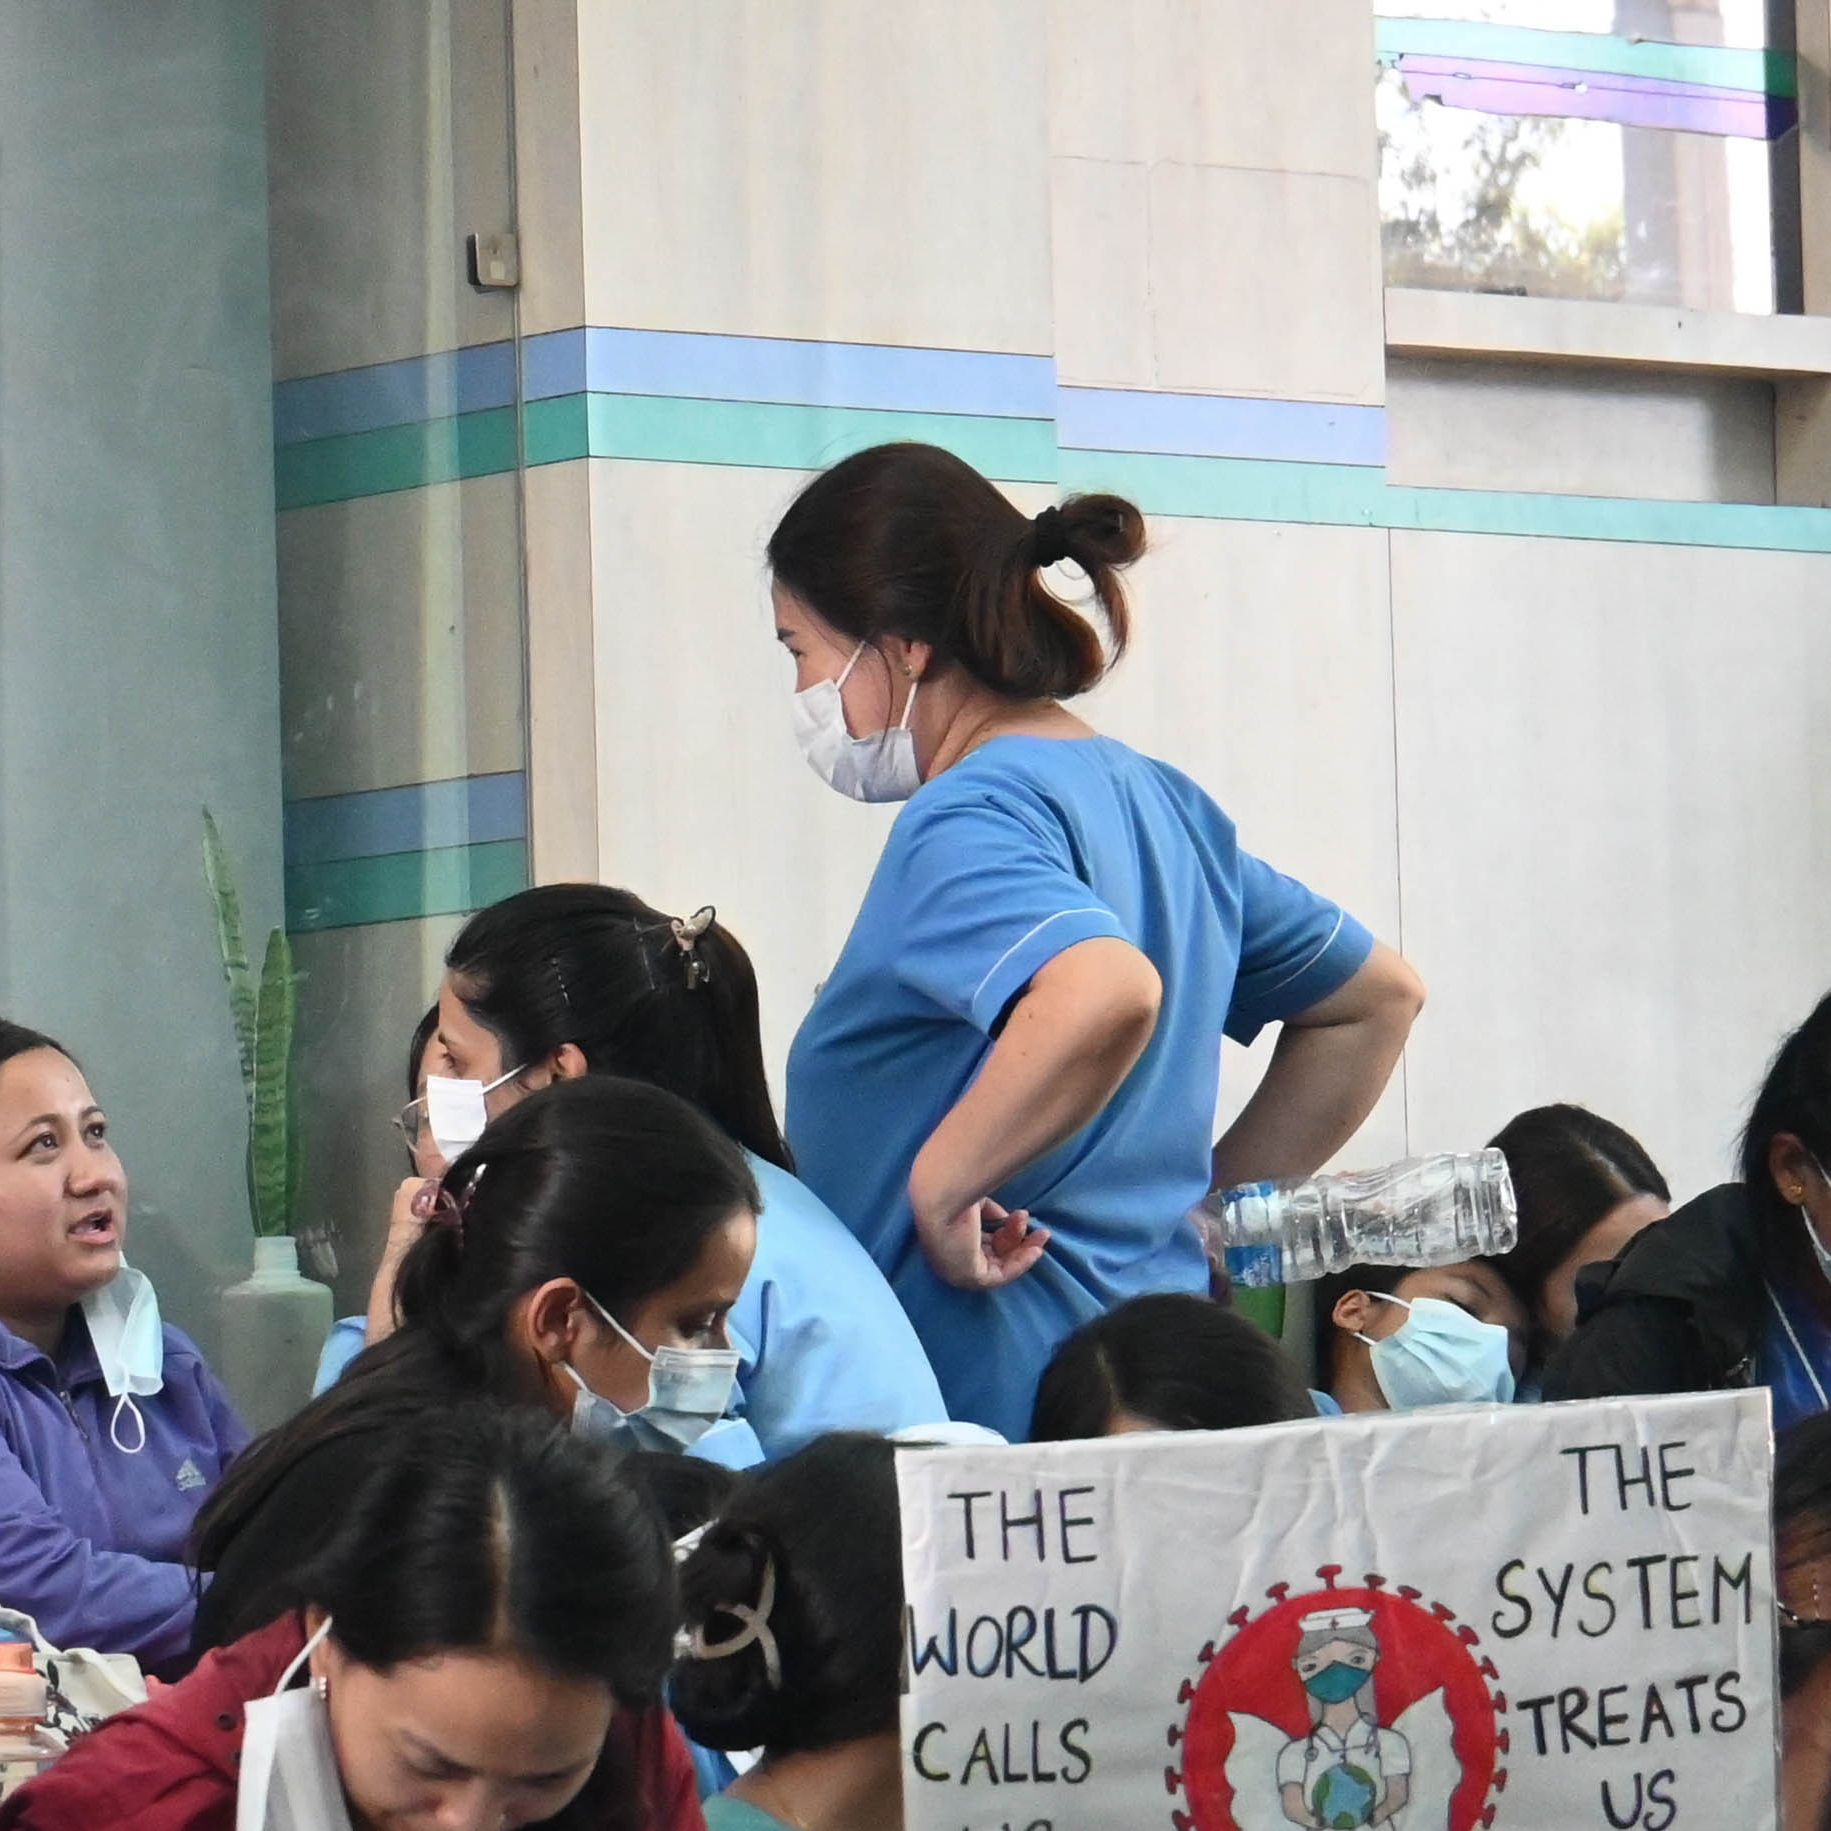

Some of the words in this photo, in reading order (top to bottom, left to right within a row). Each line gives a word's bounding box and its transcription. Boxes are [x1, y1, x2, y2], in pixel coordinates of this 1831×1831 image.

[1559, 1439, 1697, 1516] THE
[947, 1484, 1099, 1565] THE
[1492, 1552, 1753, 1639] SYSTEM
[909, 1603, 1118, 1684] WORLD
[912, 1719, 1092, 1787] CALLS
[1515, 1671, 1747, 1757] TREATS
